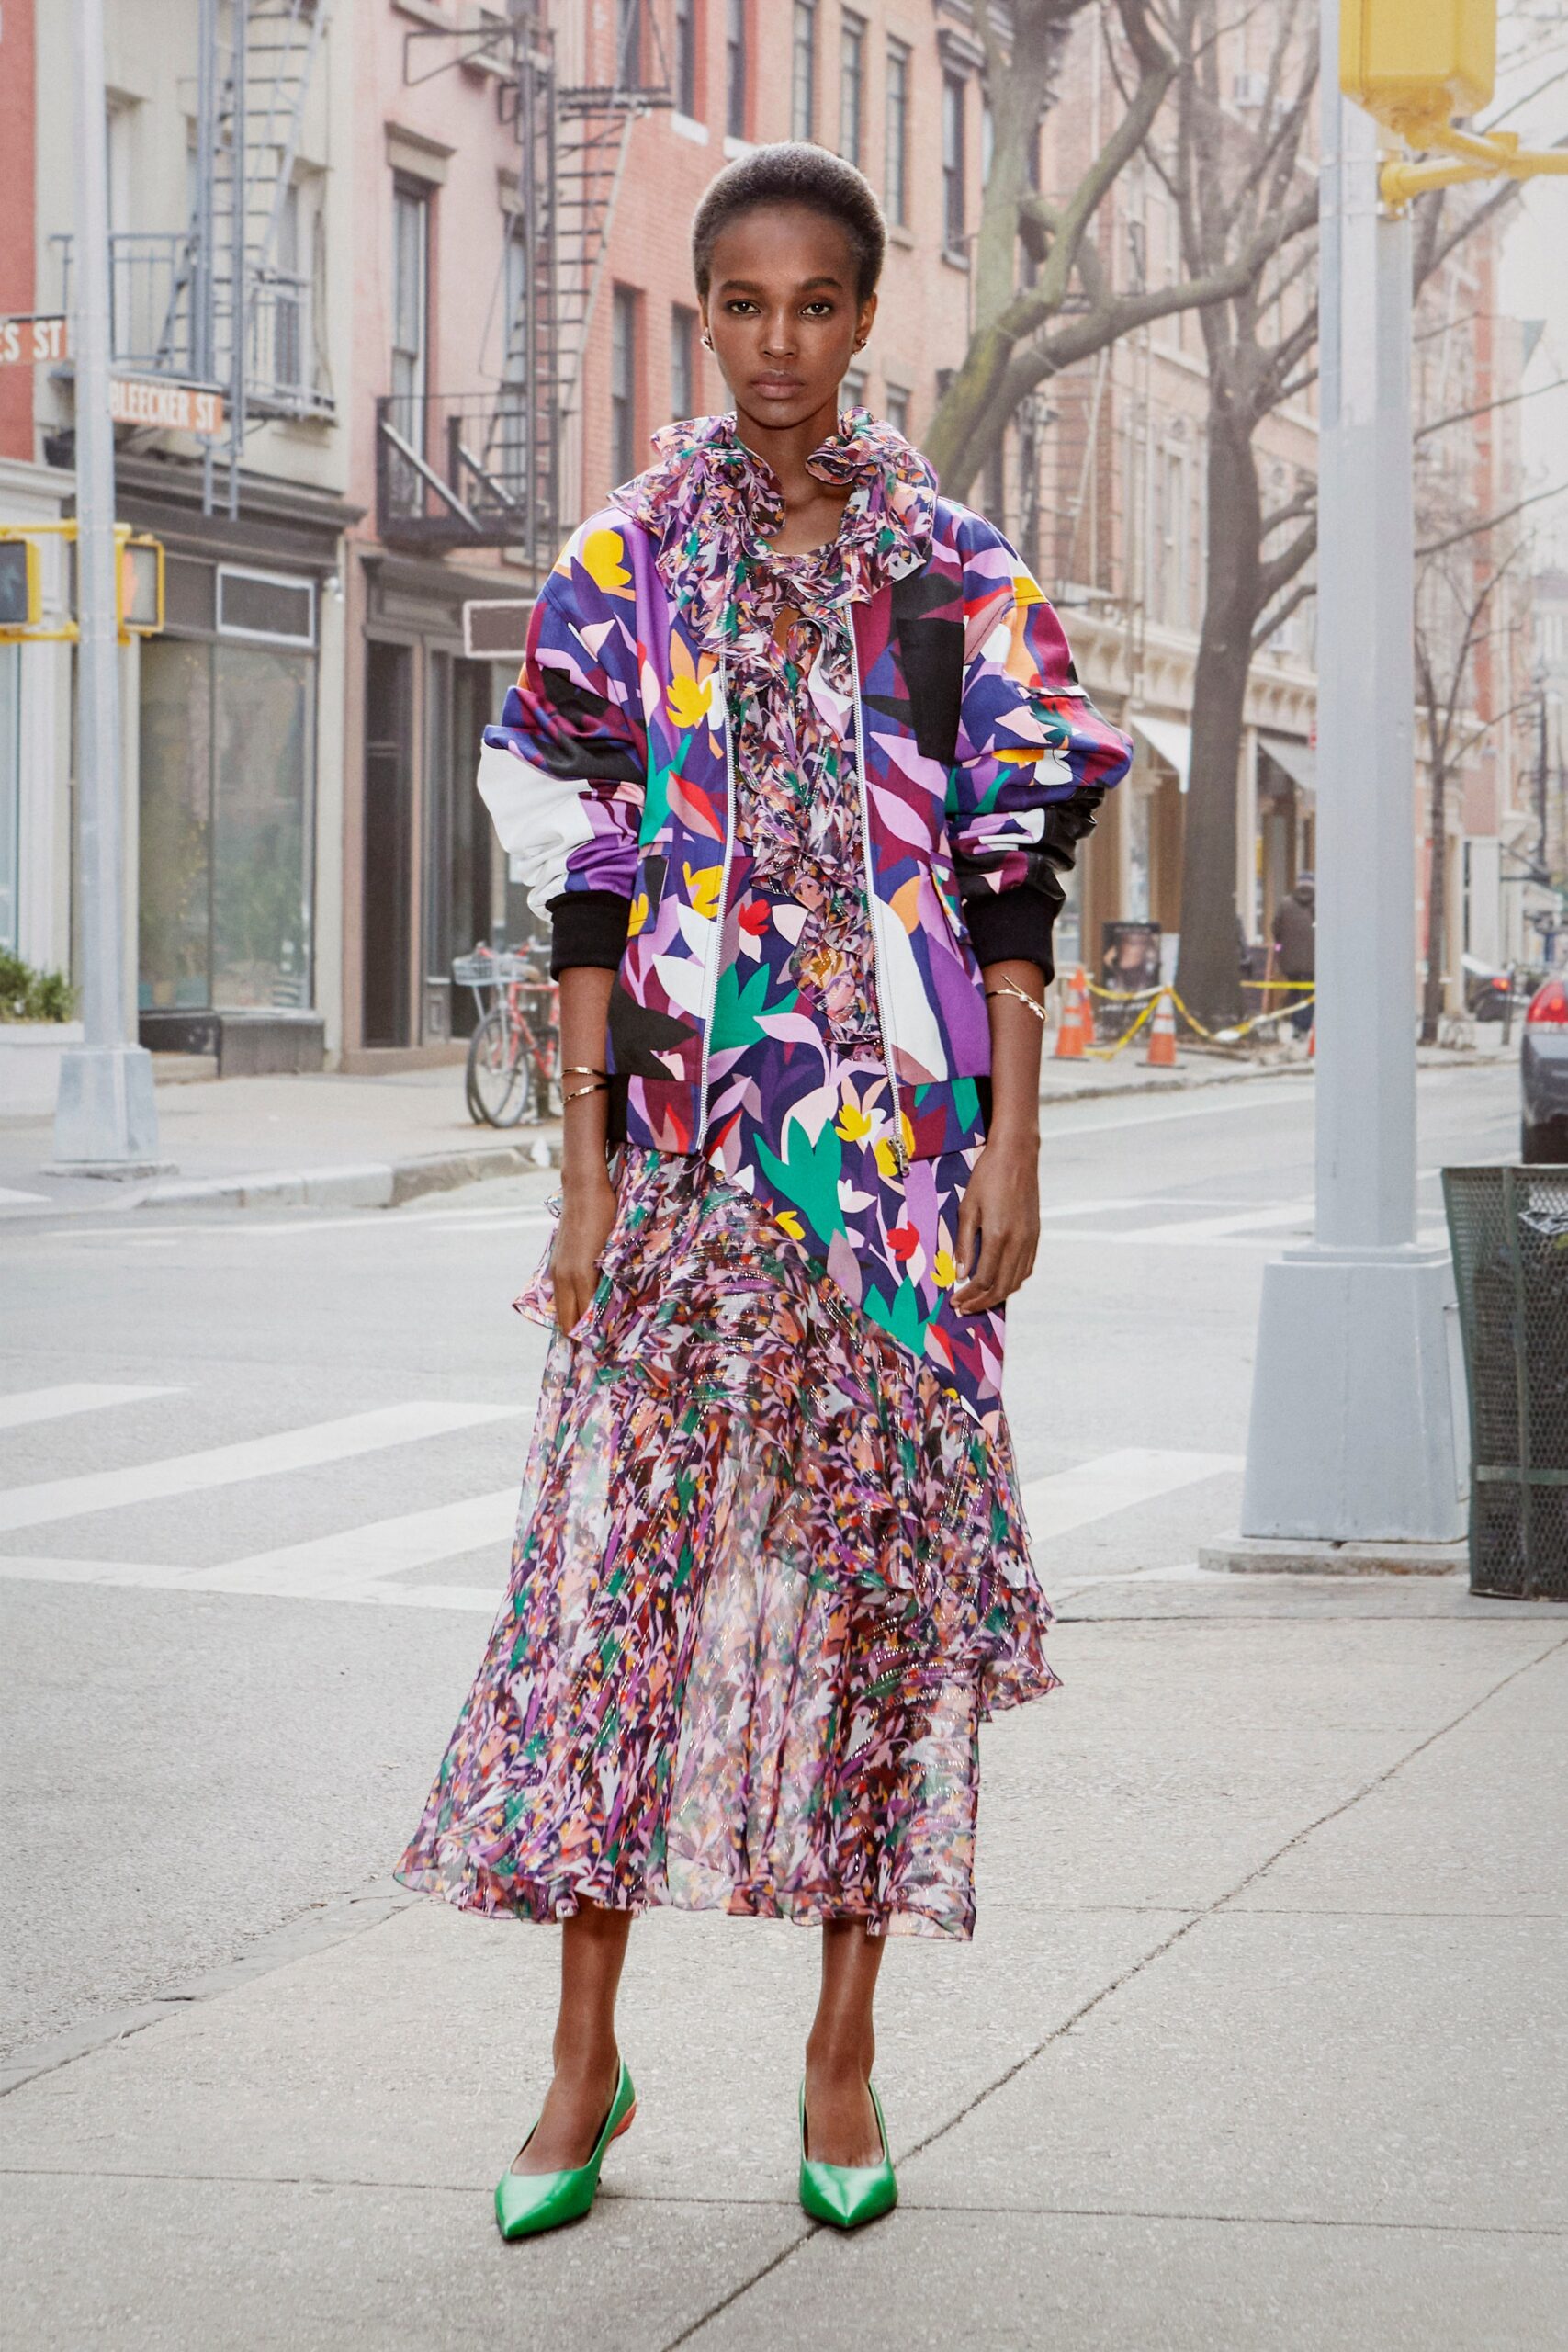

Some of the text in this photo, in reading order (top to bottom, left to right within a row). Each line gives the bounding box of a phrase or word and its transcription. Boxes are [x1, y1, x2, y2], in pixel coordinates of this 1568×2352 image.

[0, 321, 62, 361] S ST
[109, 380, 215, 430] BLEECKER ST
